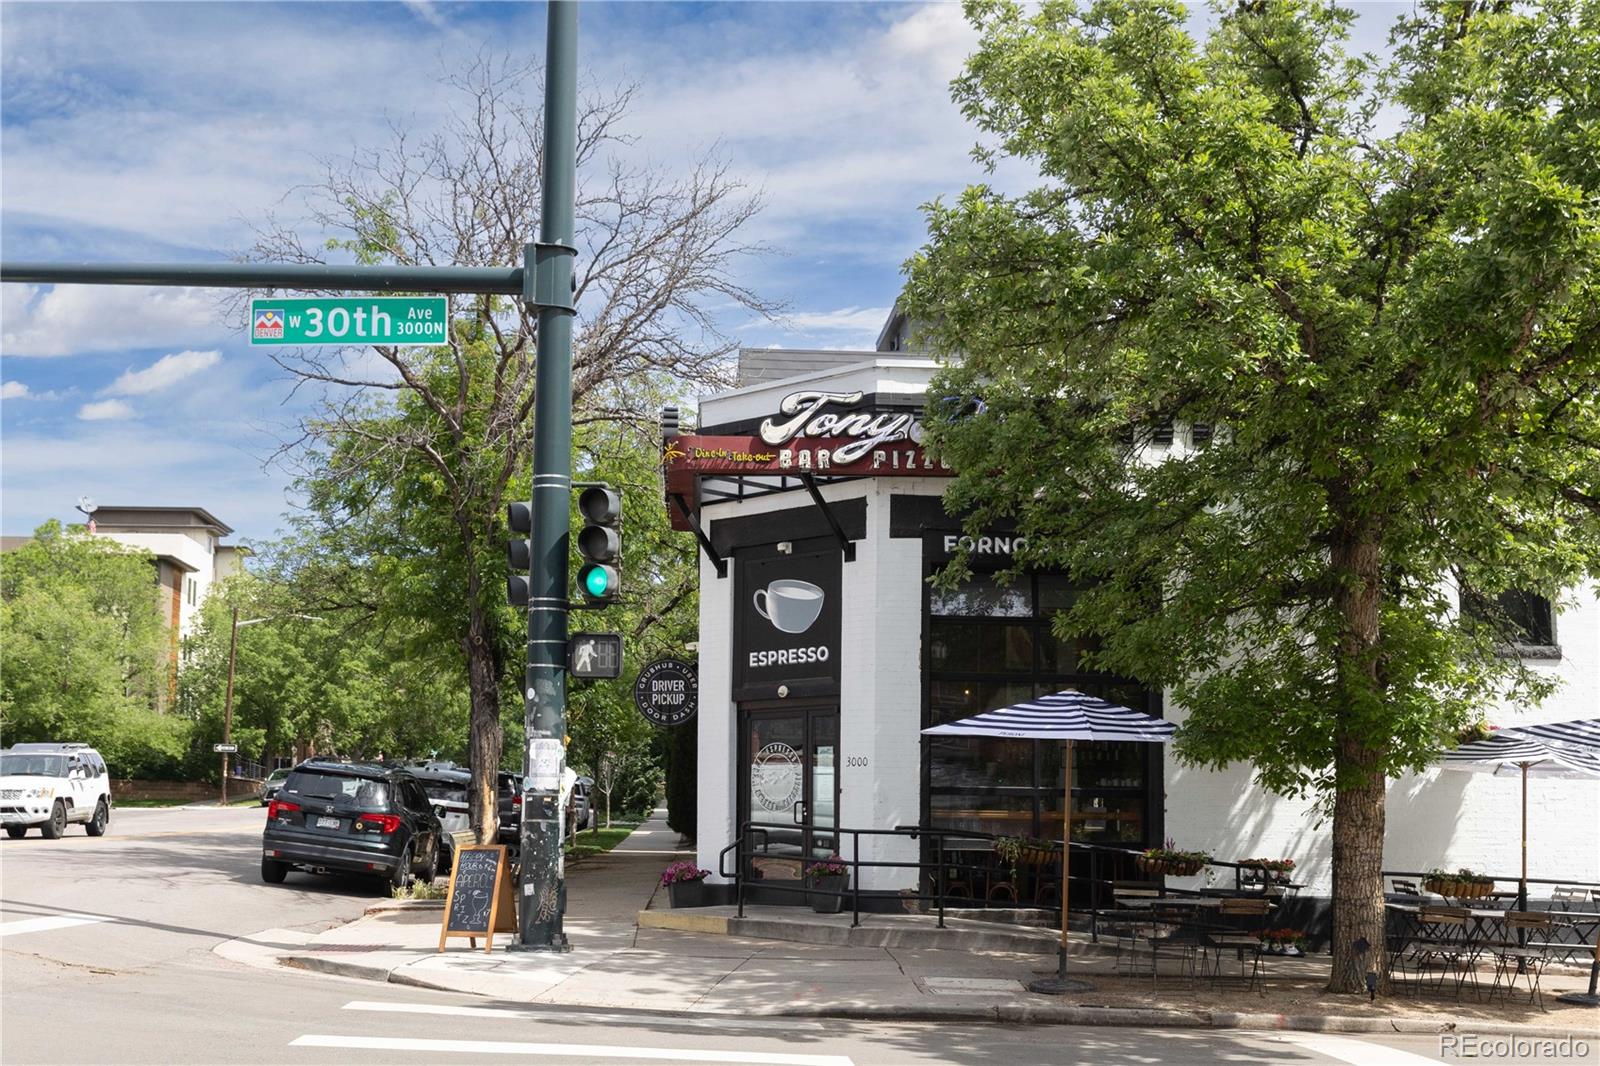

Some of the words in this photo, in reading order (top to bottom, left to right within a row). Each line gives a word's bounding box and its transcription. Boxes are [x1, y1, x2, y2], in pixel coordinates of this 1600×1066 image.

[407, 307, 433, 320] Ave
[289, 315, 302, 329] W
[304, 305, 392, 337] 30th
[396, 321, 443, 335] 3000N
[254, 327, 283, 338] DENVER
[779, 449, 831, 469] BAR
[749, 646, 829, 667] ESPRESSO
[639, 662, 673, 689] GRUBHUB
[682, 667, 698, 688] UBER
[652, 680, 685, 692] DRIVER
[652, 693, 685, 705] PICKUP
[641, 701, 667, 720] DOOR
[672, 701, 696, 720] DASH
[846, 756, 869, 768] 3000
